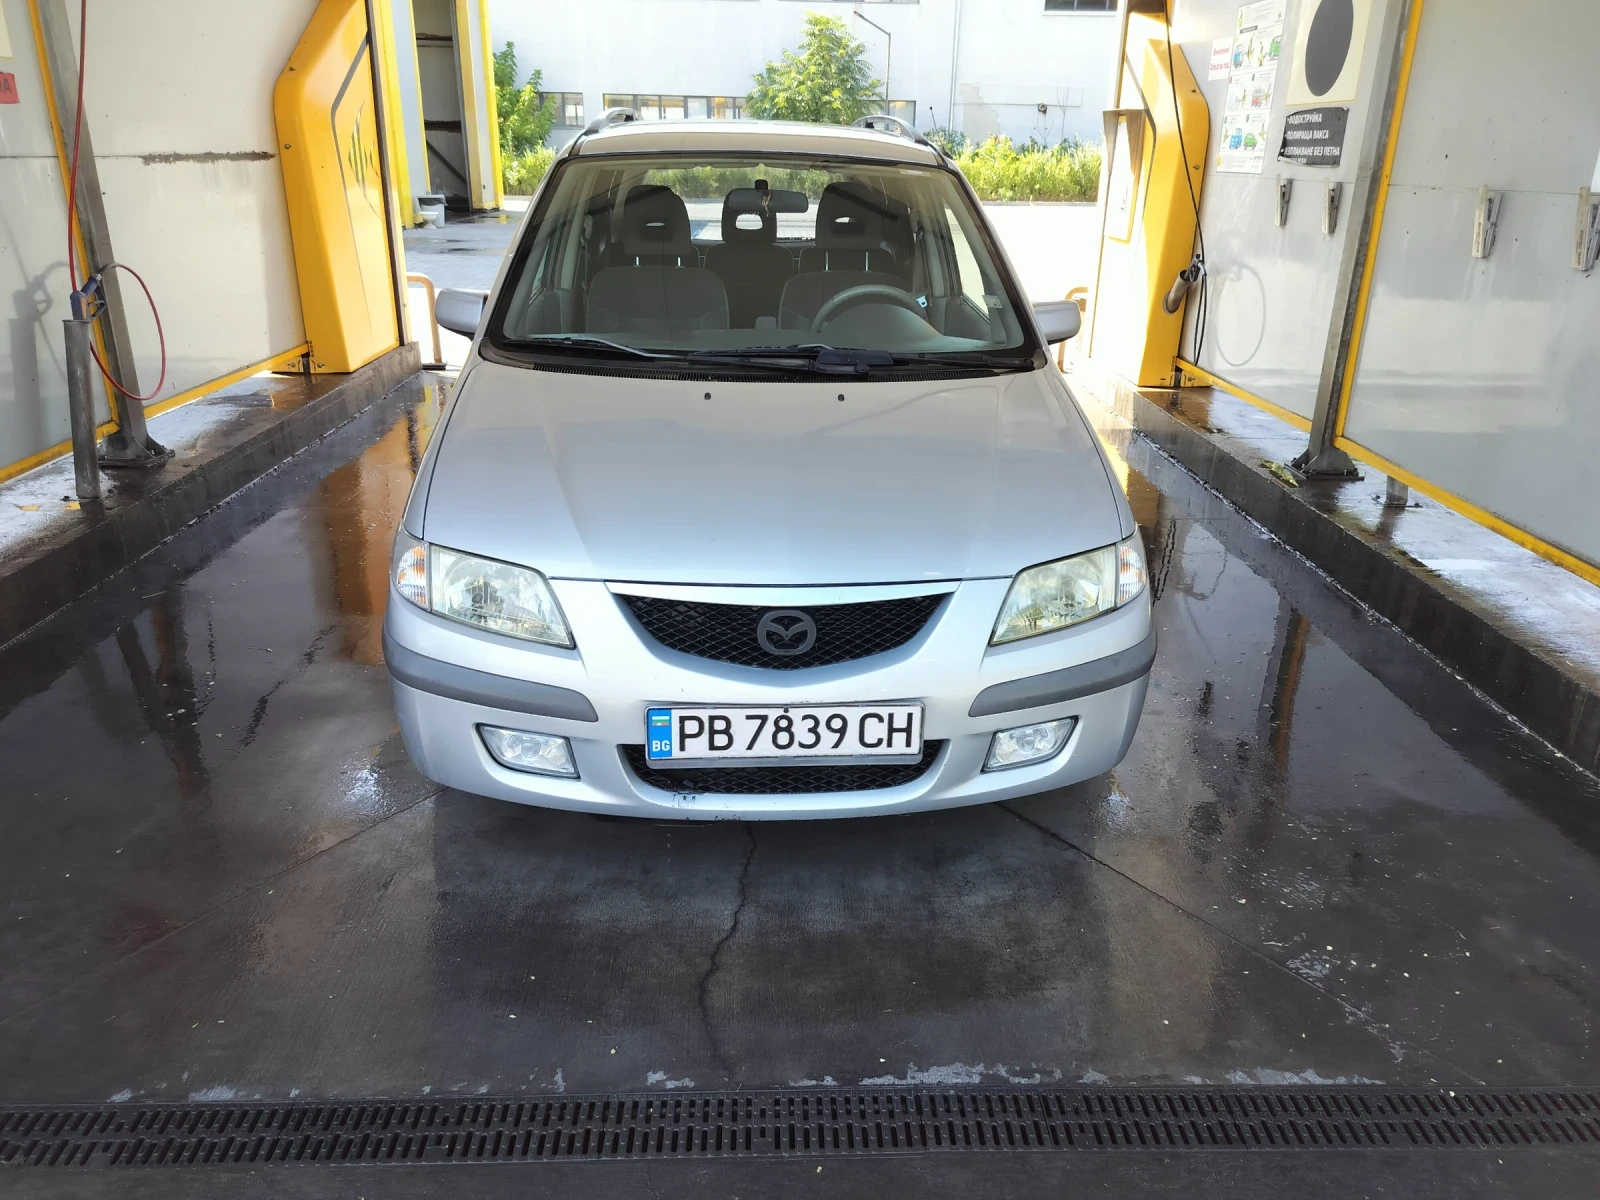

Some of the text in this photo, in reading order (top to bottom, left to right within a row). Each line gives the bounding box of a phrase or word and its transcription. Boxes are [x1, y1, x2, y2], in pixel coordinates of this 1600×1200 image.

[1288, 112, 1322, 124] ВОДОСТРУЙКА
[1286, 130, 1329, 140] ПОЛИРАЩА ВАКСА
[1284, 147, 1340, 156] ИЗПЛАКВАНЕ БЕЗ ПЕТНА
[678, 713, 913, 751] PB 7839 CH
[652, 740, 670, 751] BG
